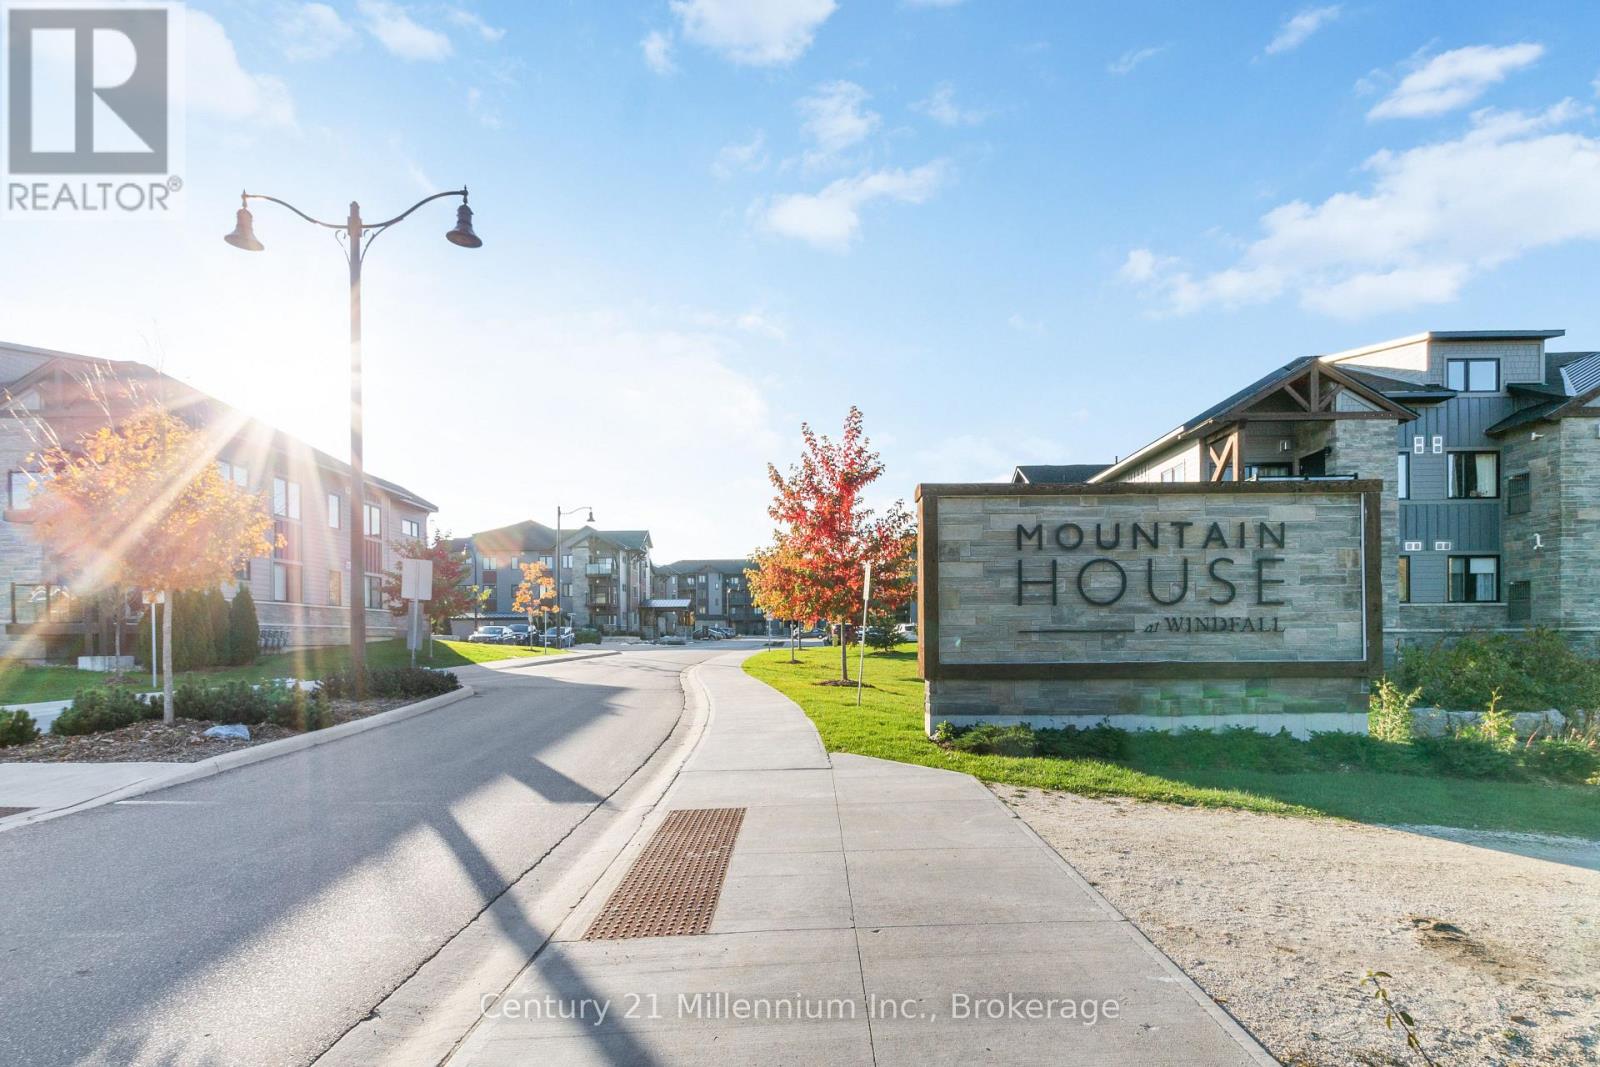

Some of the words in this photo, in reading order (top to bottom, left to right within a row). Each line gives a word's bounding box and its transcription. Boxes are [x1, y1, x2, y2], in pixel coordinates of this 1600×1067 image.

[1016, 521, 1286, 551] MOUNTAIN
[1017, 557, 1286, 607] HOUSE
[1143, 620, 1160, 634] at
[1164, 616, 1286, 634] WINDFALL
